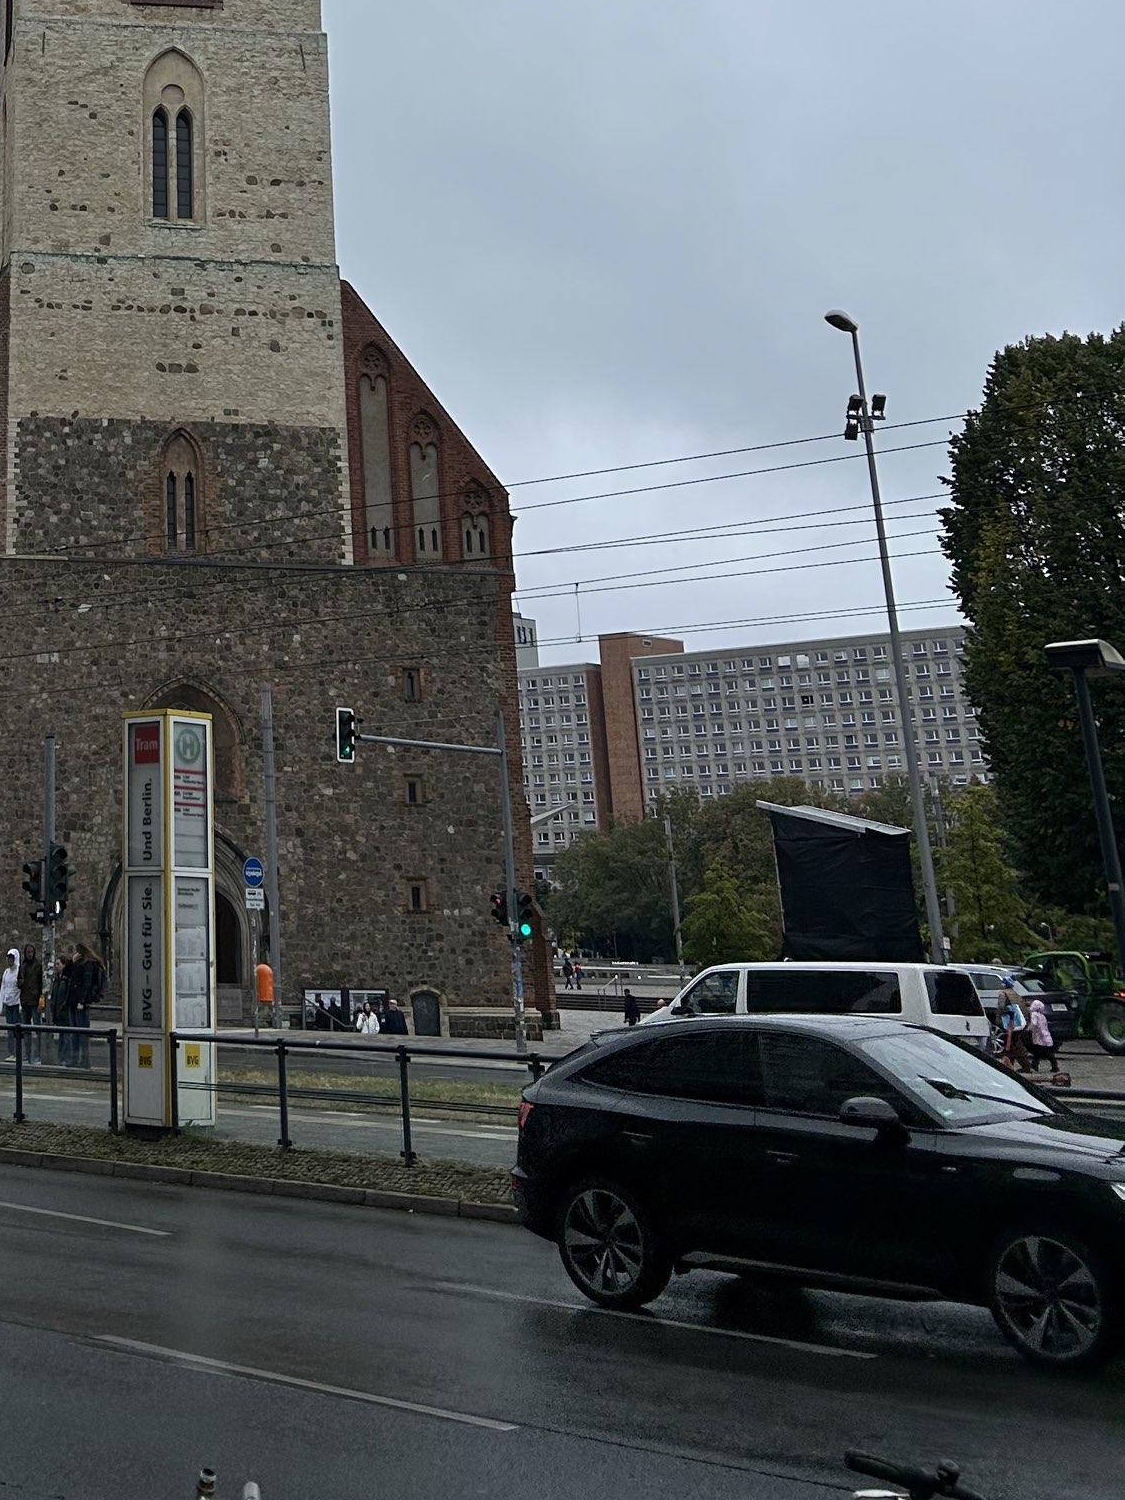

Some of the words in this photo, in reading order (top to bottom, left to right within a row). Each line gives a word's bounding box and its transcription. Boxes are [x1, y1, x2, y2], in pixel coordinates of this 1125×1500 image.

[136, 738, 158, 751] Tram
[142, 778, 153, 826] Berlin.
[142, 830, 153, 861] Und
[142, 883, 153, 911] Sie.
[141, 916, 153, 938] für
[142, 943, 153, 971] Gut
[142, 988, 153, 1022] BVG
[139, 1055, 152, 1066] BVG
[186, 1055, 199, 1066] BVG
